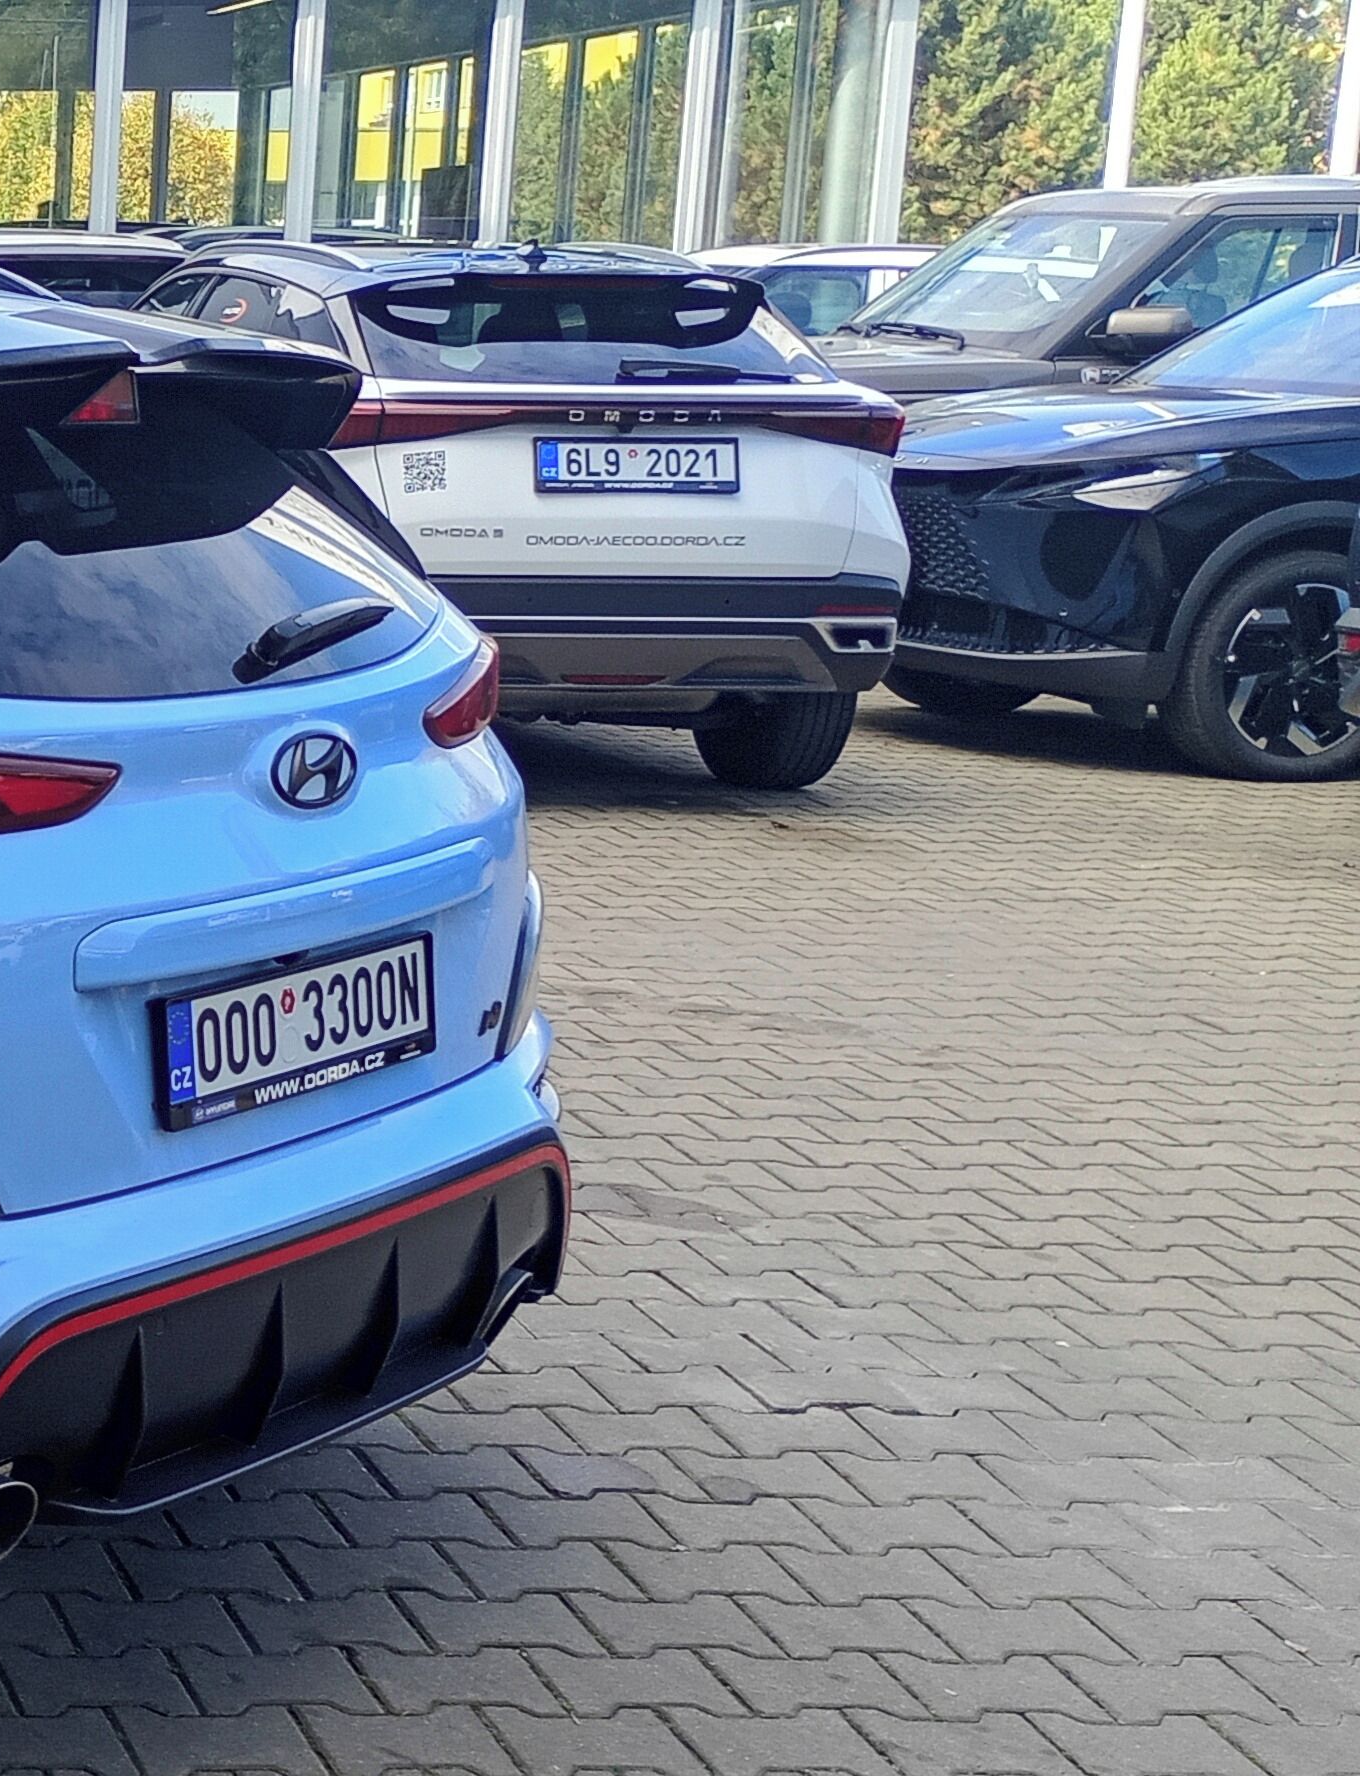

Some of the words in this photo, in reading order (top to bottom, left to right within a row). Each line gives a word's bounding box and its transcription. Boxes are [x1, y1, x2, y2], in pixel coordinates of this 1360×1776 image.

[541, 467, 558, 477] CZ
[566, 448, 620, 477] 6L9
[646, 448, 718, 478] 2021
[420, 527, 489, 538] OMODA
[526, 535, 746, 547] OMODA-JAECOO.DORDA.CZ
[302, 952, 420, 1052] 3300N
[170, 1065, 193, 1092] CZ
[254, 1051, 386, 1105] WWW.DORDA.CZ
